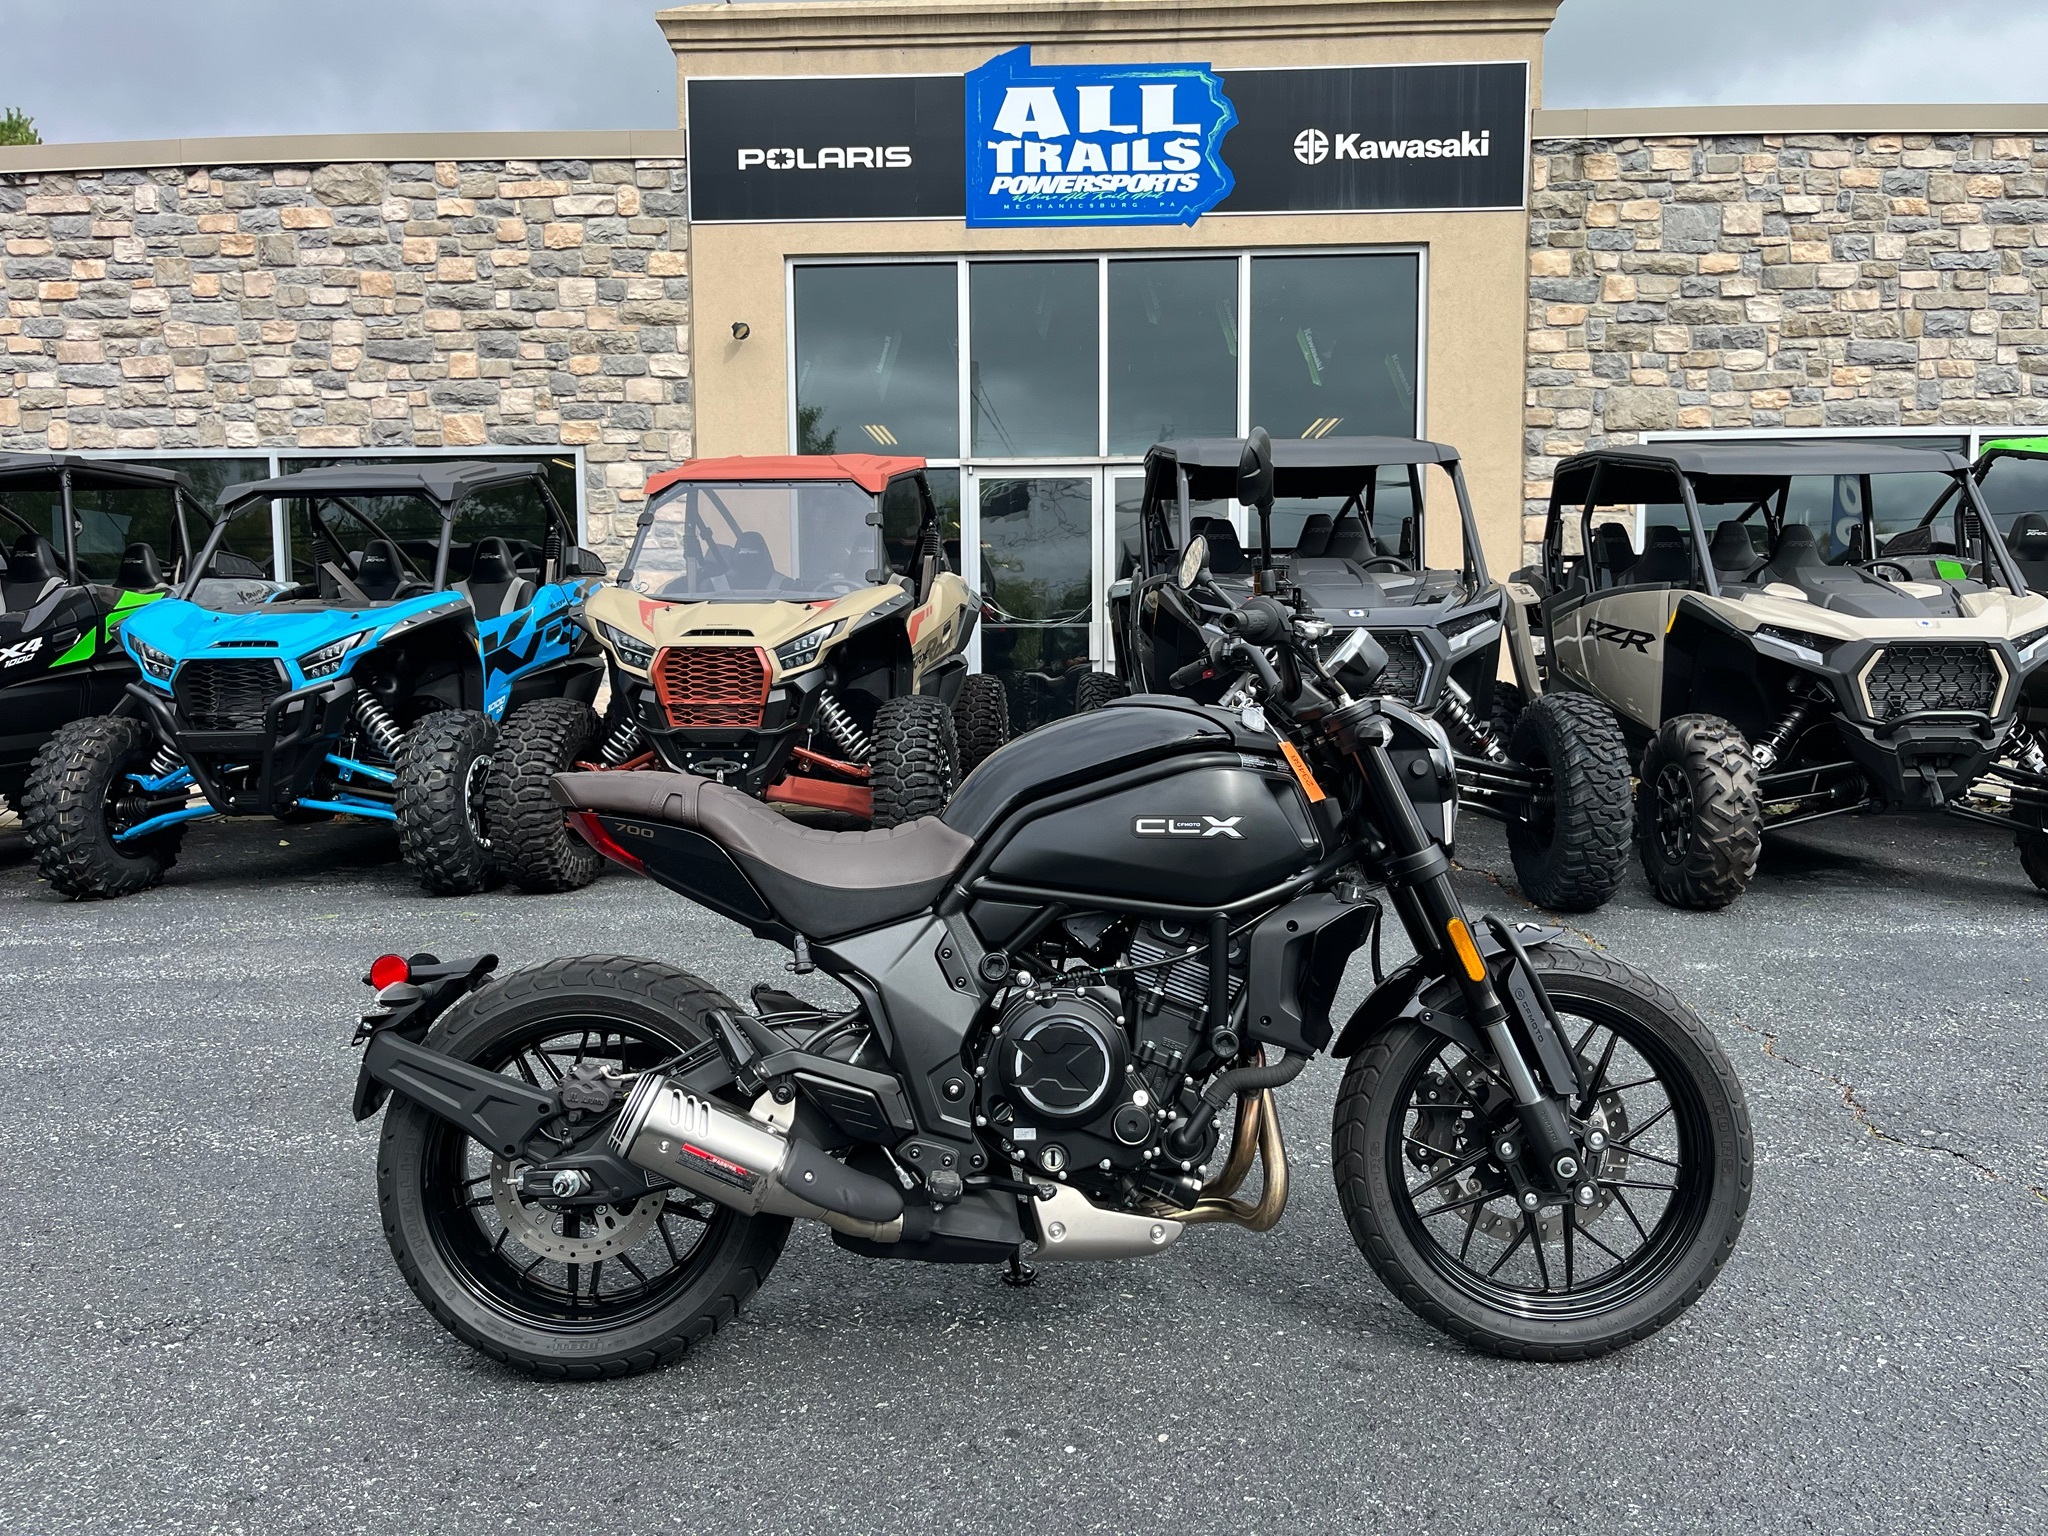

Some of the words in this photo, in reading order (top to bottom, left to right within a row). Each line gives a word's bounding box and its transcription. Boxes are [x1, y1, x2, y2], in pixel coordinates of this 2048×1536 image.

[993, 84, 1201, 139] ALL
[988, 138, 1201, 173] TRAILS
[1335, 130, 1490, 160] Kawasaki
[738, 146, 912, 170] POLARIS
[989, 173, 1200, 194] POWERSPORTS
[1584, 618, 1656, 654] RZR
[4, 653, 35, 668] 1000
[487, 695, 506, 712] 1000
[614, 822, 655, 838] 700
[1136, 816, 1243, 836] CLX
[1522, 1001, 1544, 1042] CFMOTO
